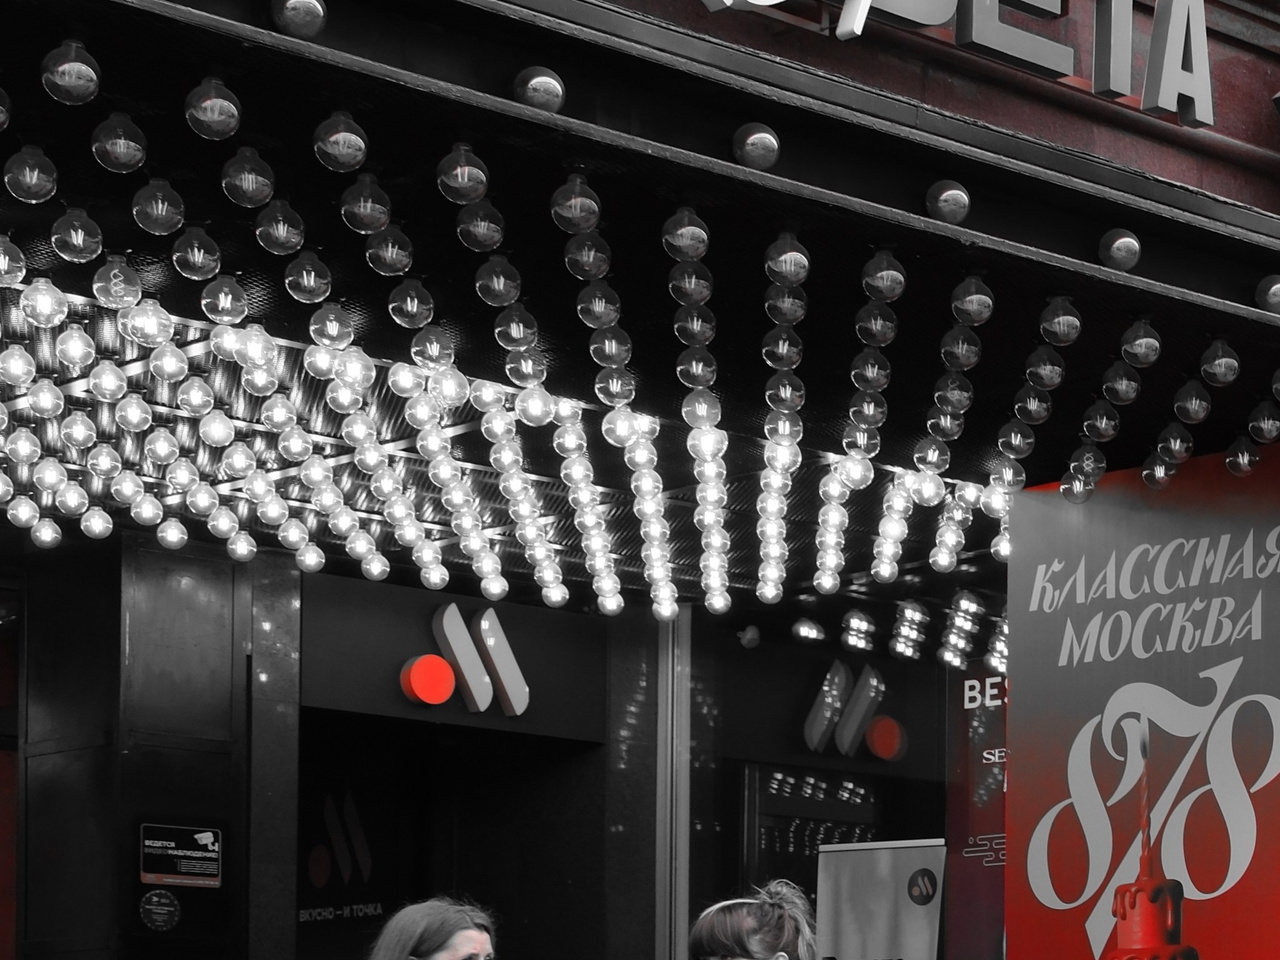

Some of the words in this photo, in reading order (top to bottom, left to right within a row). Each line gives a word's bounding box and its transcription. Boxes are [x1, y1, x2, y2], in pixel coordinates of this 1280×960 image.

[1058, 589, 1263, 668] МОСКВА
[963, 676, 1008, 710] BE
[352, 903, 383, 917] ТОЧКА
